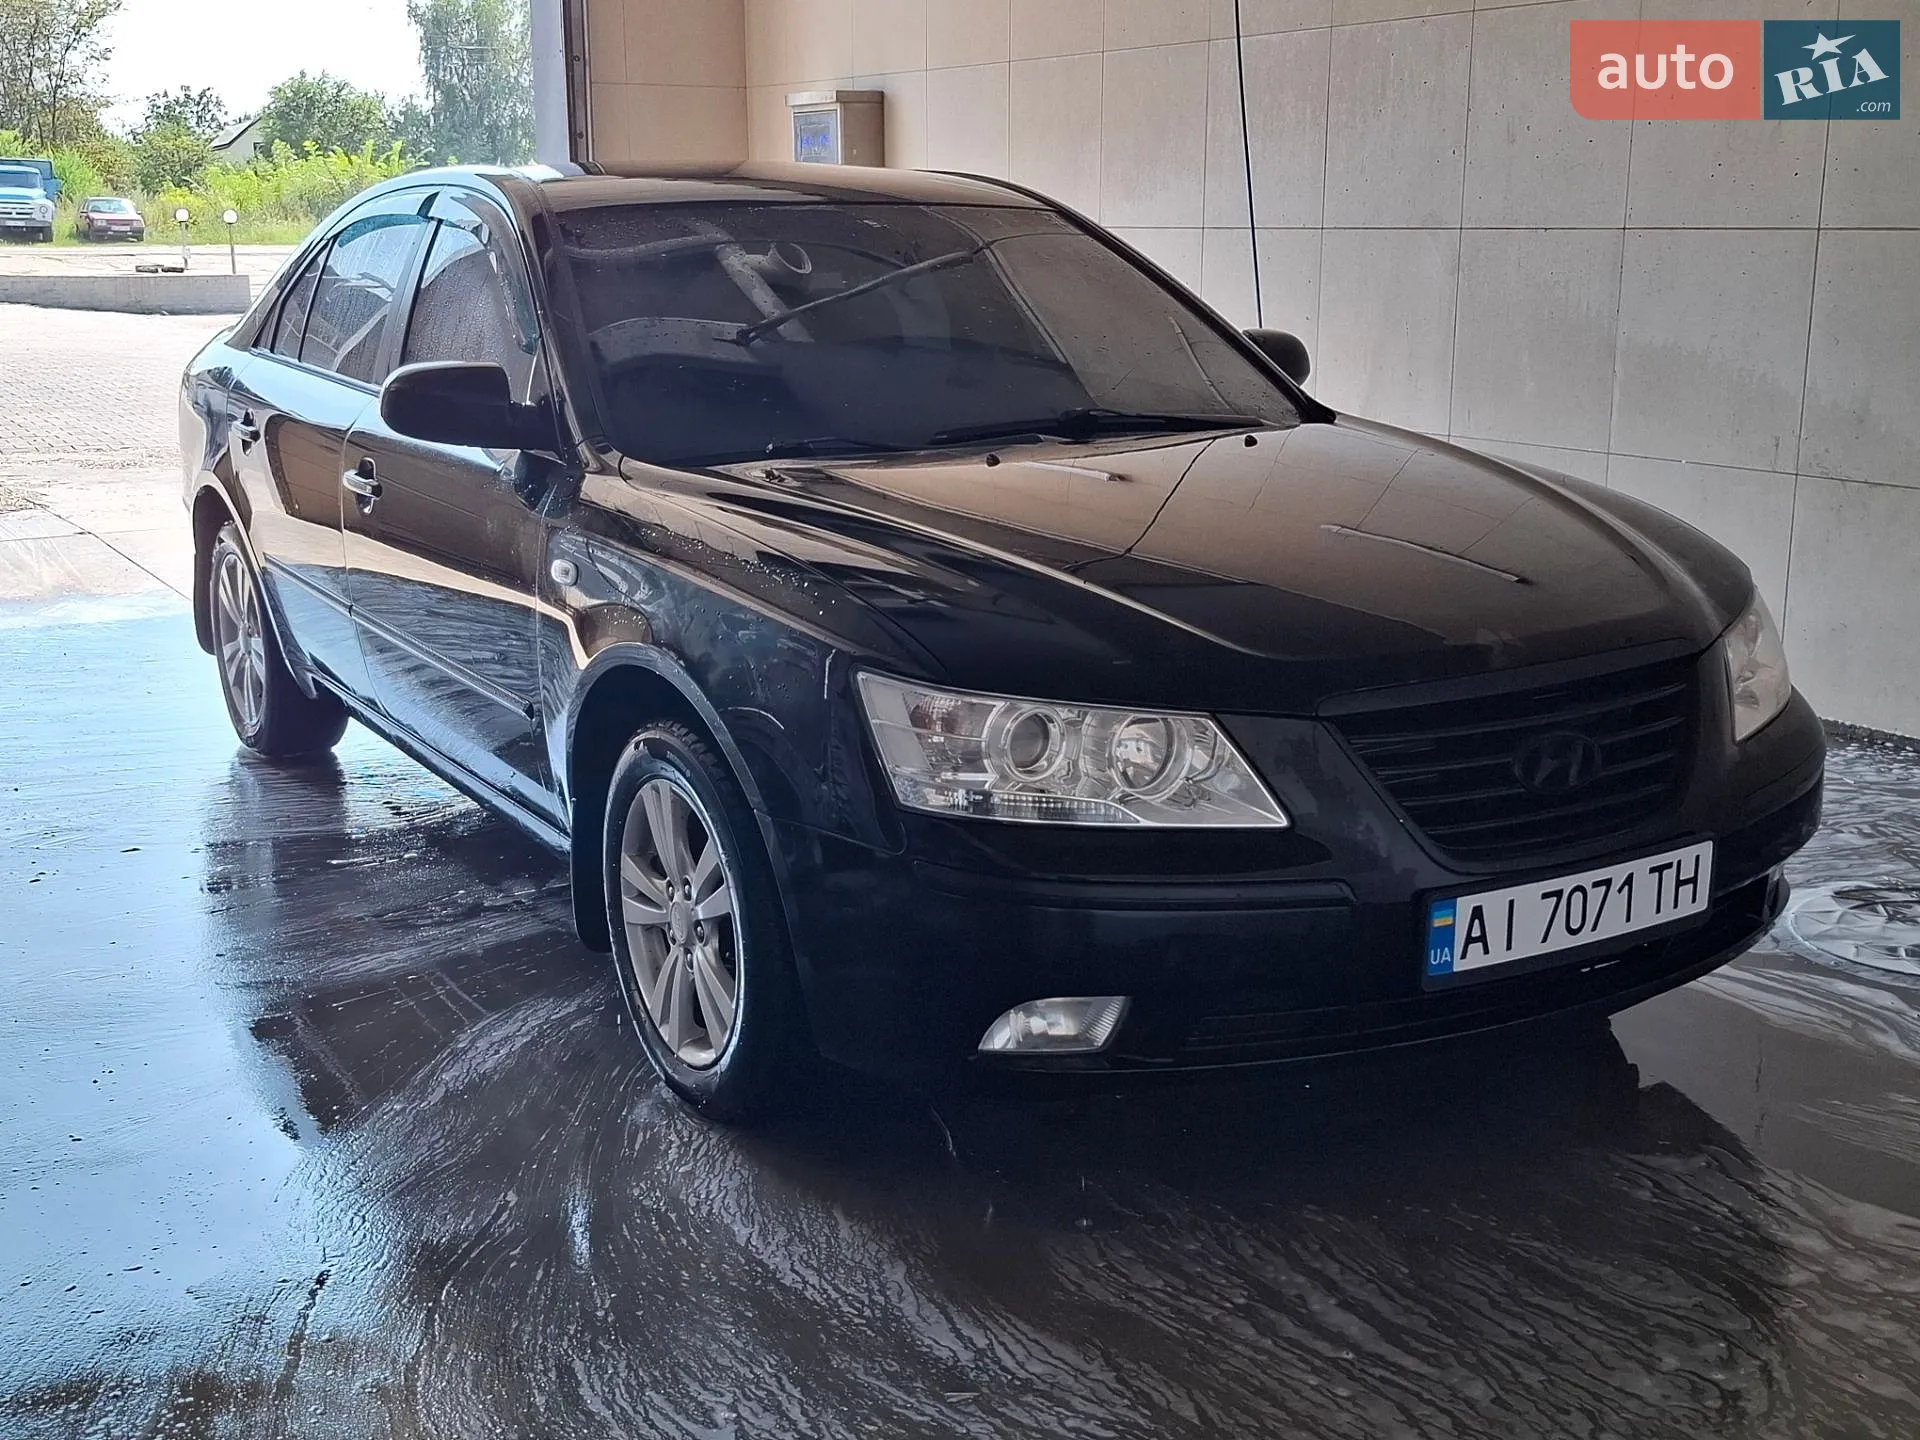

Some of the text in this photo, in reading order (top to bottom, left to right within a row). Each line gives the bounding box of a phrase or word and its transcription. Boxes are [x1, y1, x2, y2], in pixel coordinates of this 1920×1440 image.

[1459, 854, 1701, 960] AI 7071 TH
[1430, 947, 1451, 965] UA
